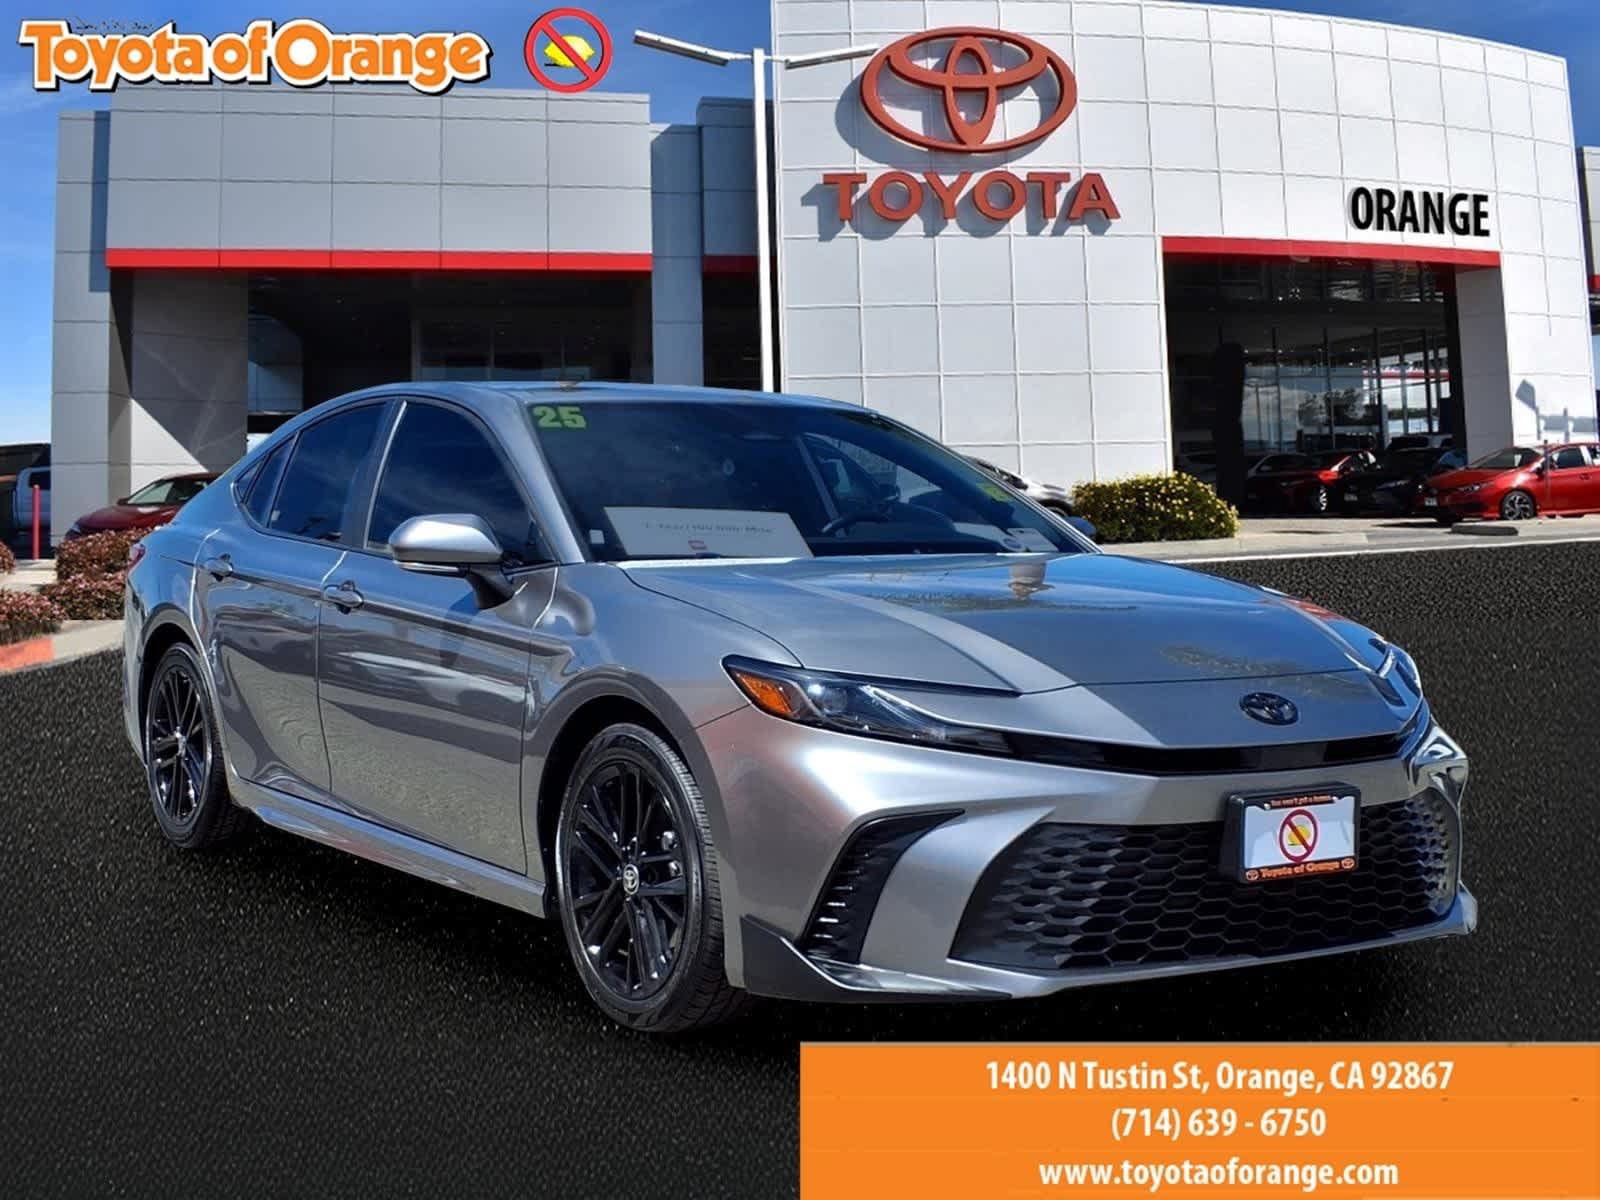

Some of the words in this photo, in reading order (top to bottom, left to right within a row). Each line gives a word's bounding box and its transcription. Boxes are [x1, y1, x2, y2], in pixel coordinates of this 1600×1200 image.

[823, 171, 1121, 222] TOYOTA
[1350, 186, 1491, 237] ORANGE
[532, 405, 587, 429] 25
